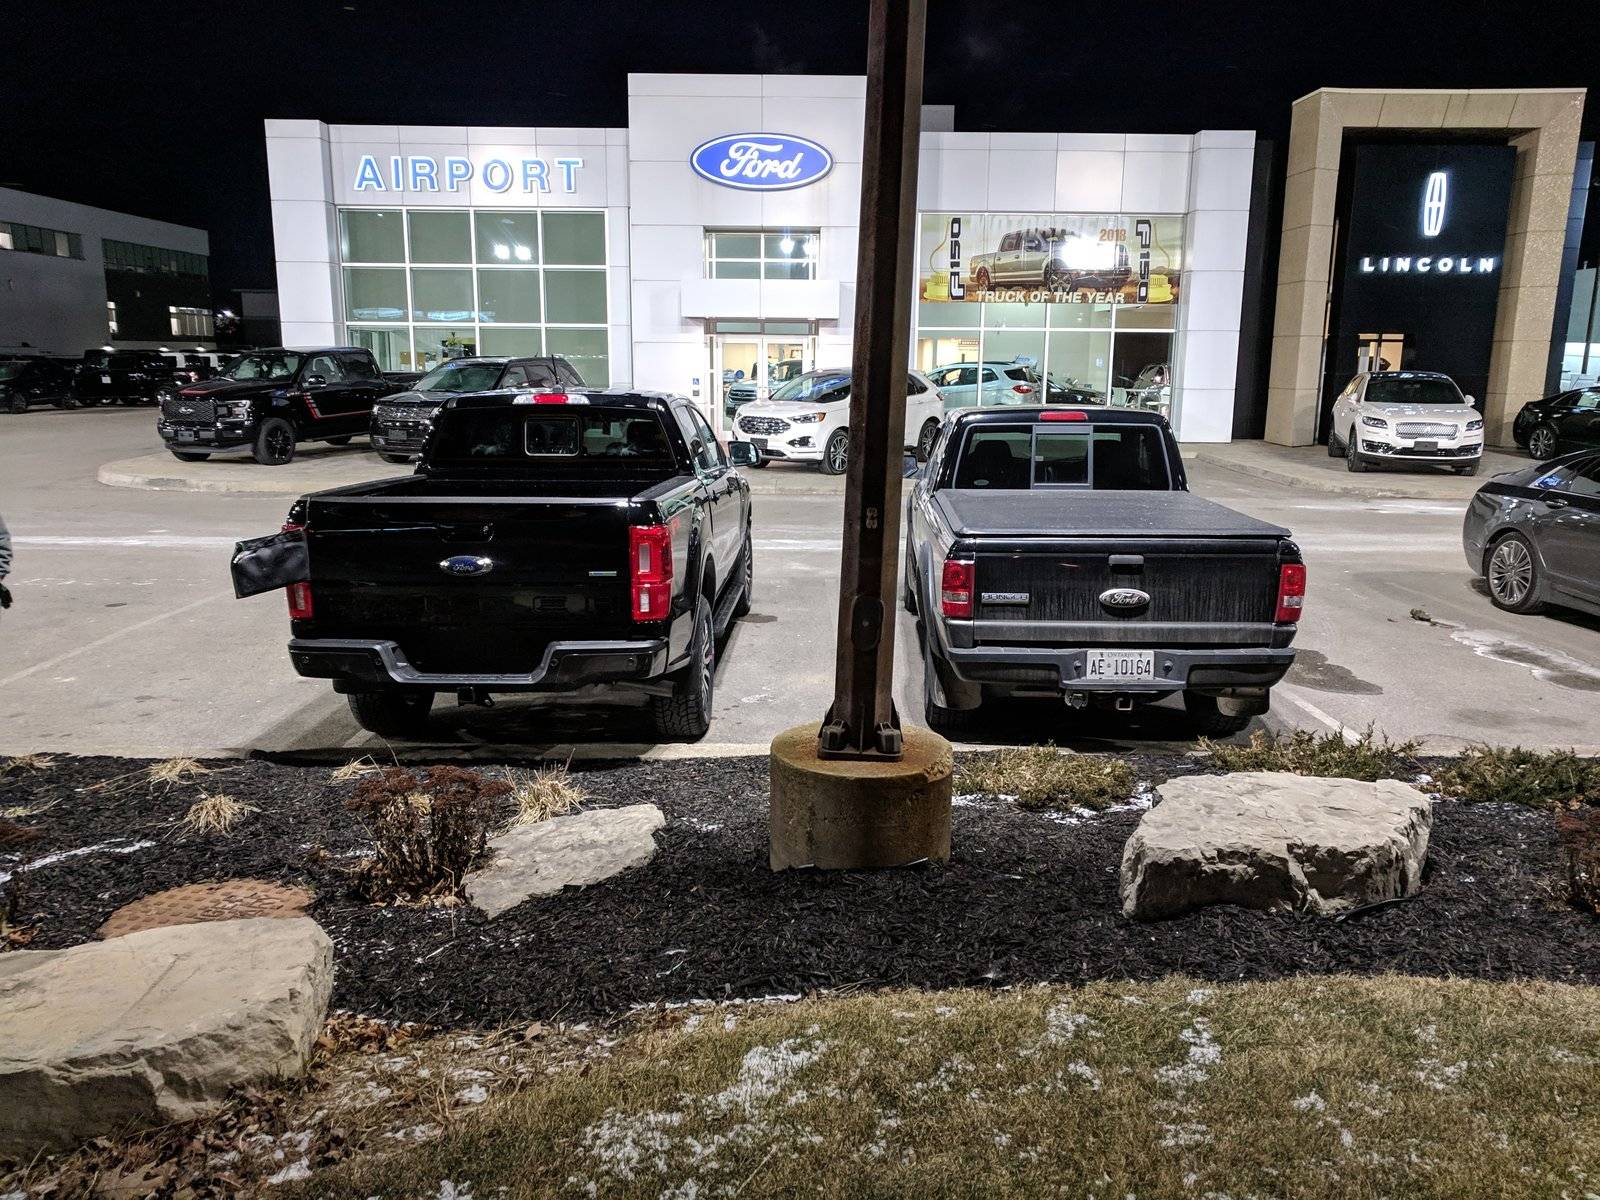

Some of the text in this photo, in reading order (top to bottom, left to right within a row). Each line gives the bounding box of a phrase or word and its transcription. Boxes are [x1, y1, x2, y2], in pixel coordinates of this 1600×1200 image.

[721, 141, 802, 179] Ford
[353, 154, 584, 194] AIRPORT
[1100, 228, 1126, 242] 2018
[1362, 256, 1494, 272] LINCOLN
[976, 290, 1125, 304] TRUCK OF THE YEAR
[1111, 592, 1139, 604] Ford
[1090, 659, 1151, 675] AE 10164
